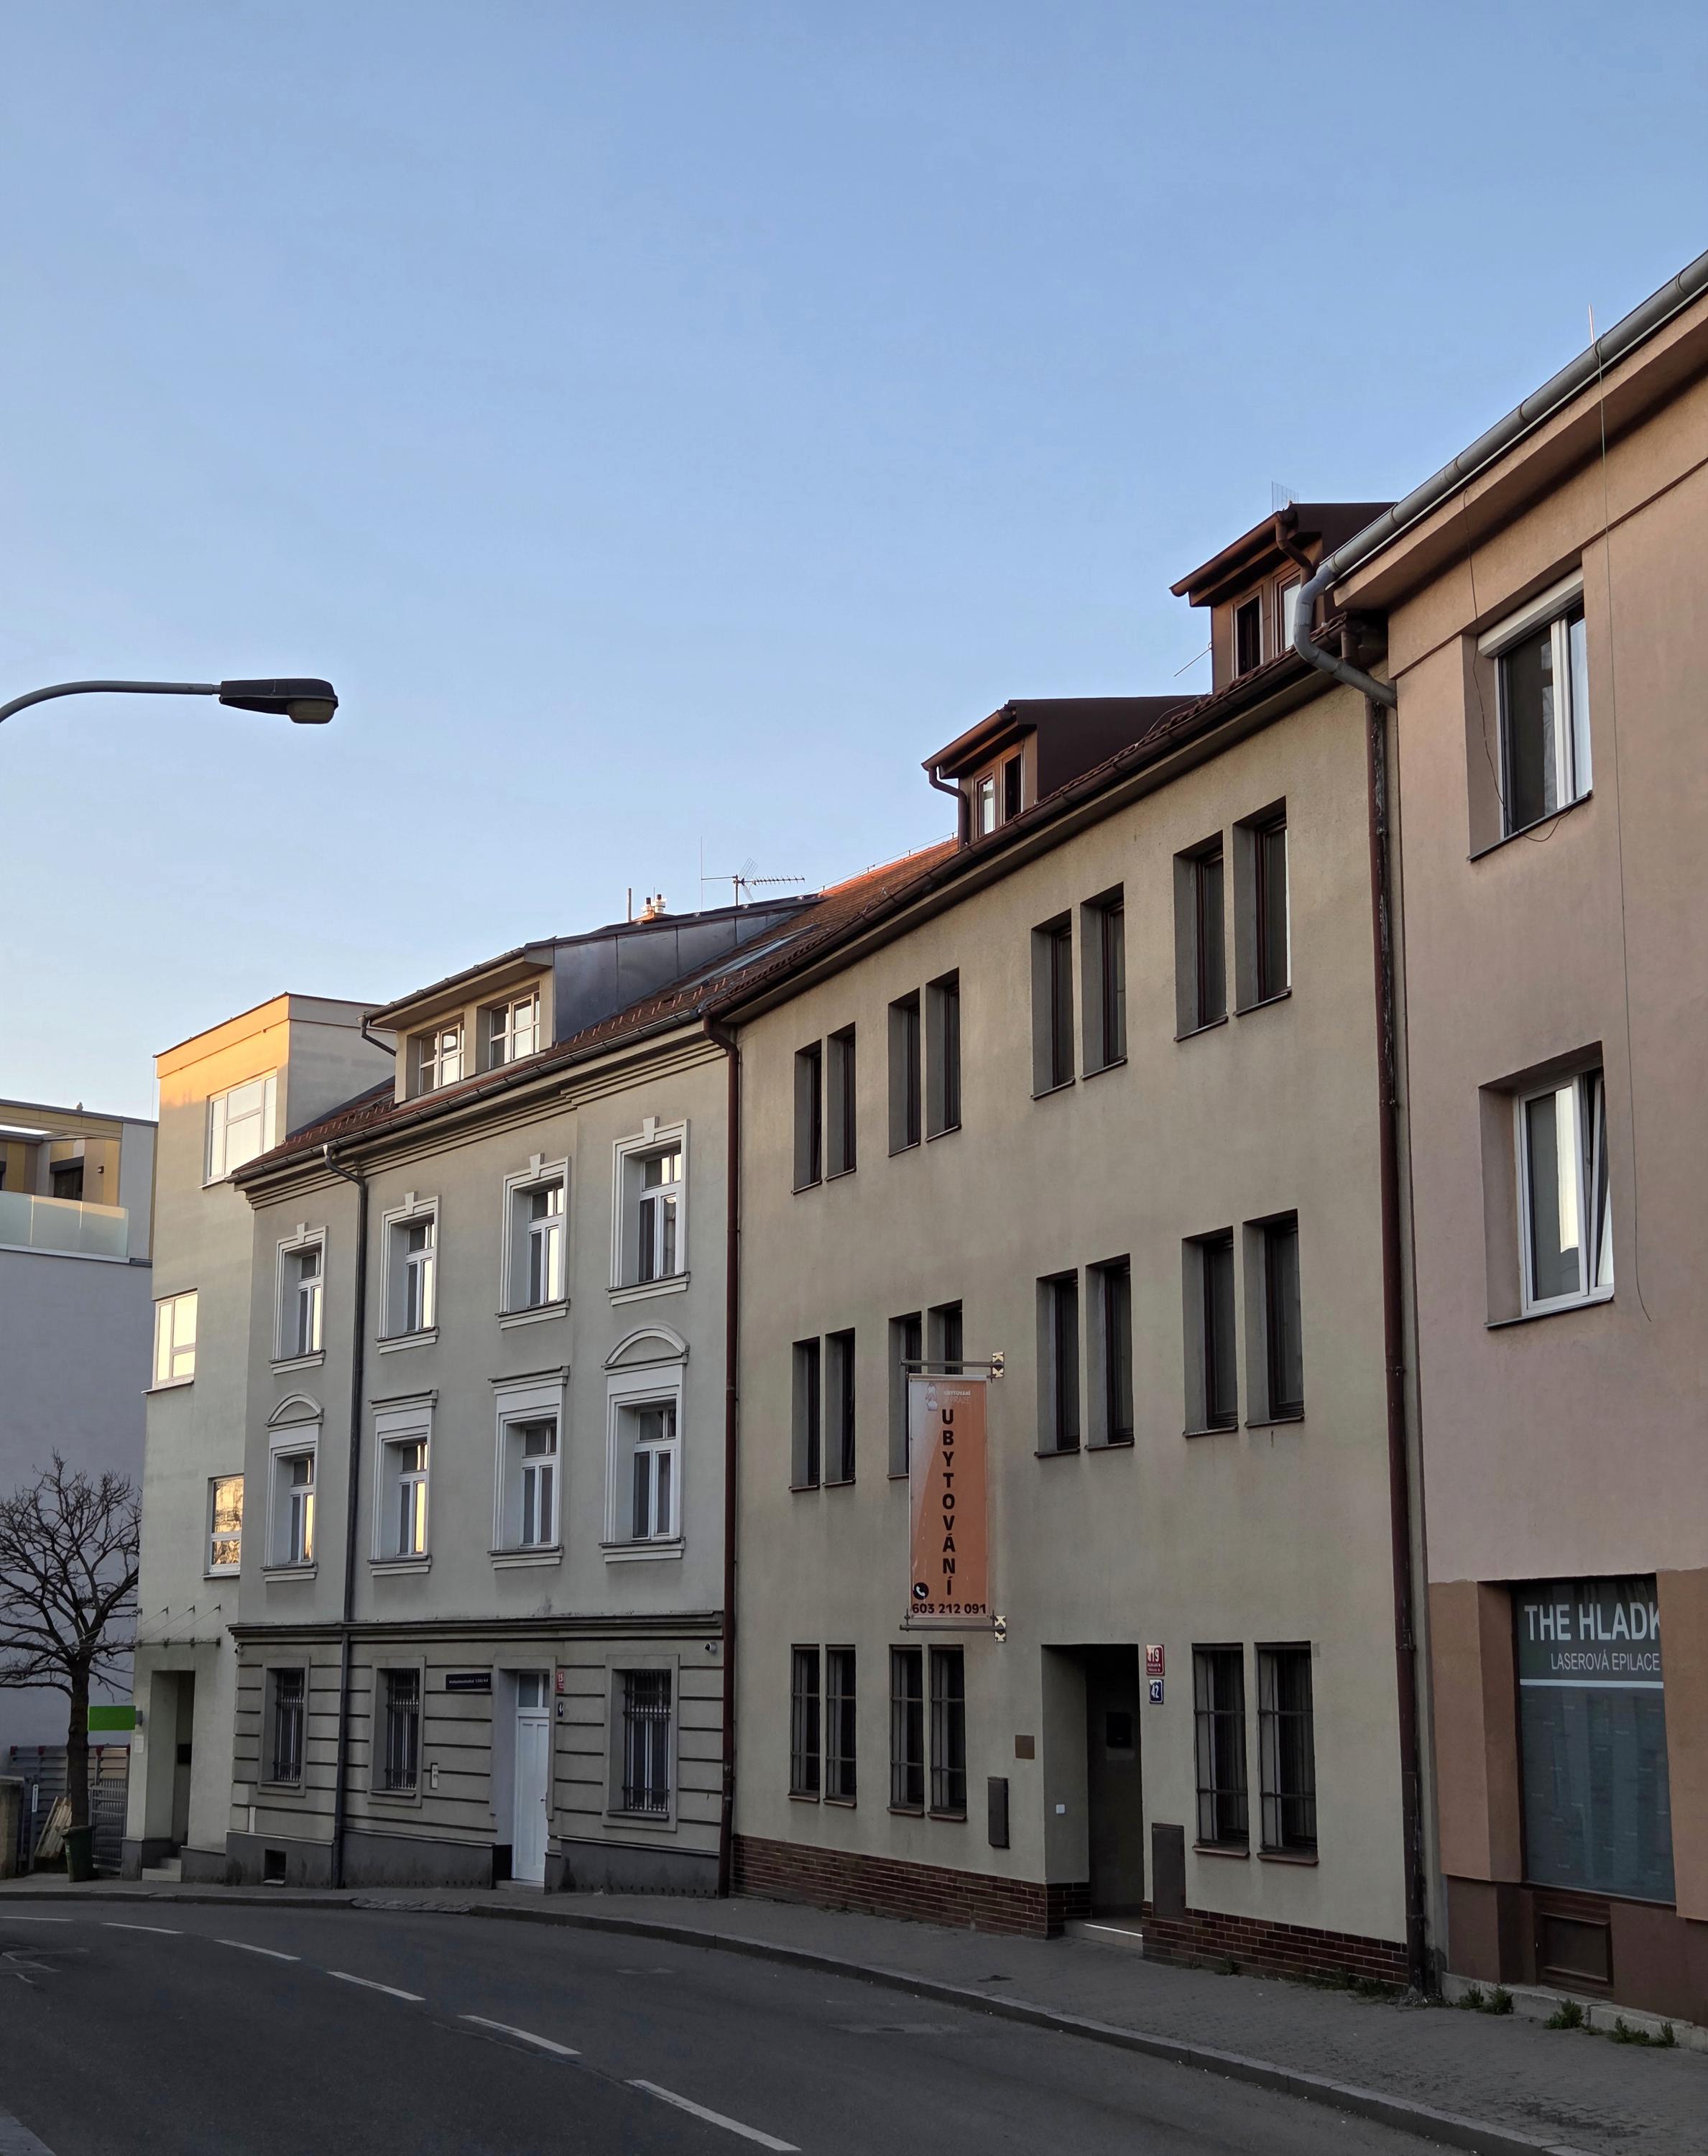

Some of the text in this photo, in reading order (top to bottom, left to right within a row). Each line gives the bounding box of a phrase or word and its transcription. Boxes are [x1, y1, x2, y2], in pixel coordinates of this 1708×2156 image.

[942, 1409, 956, 1595] UBYTOVÁNÍ
[912, 1603, 987, 1614] 603 212 091
[1524, 1604, 1571, 1641] THE
[1551, 1649, 1661, 1671] LASEROVÁ EPILACE
[1151, 1685, 1159, 1698] 42
